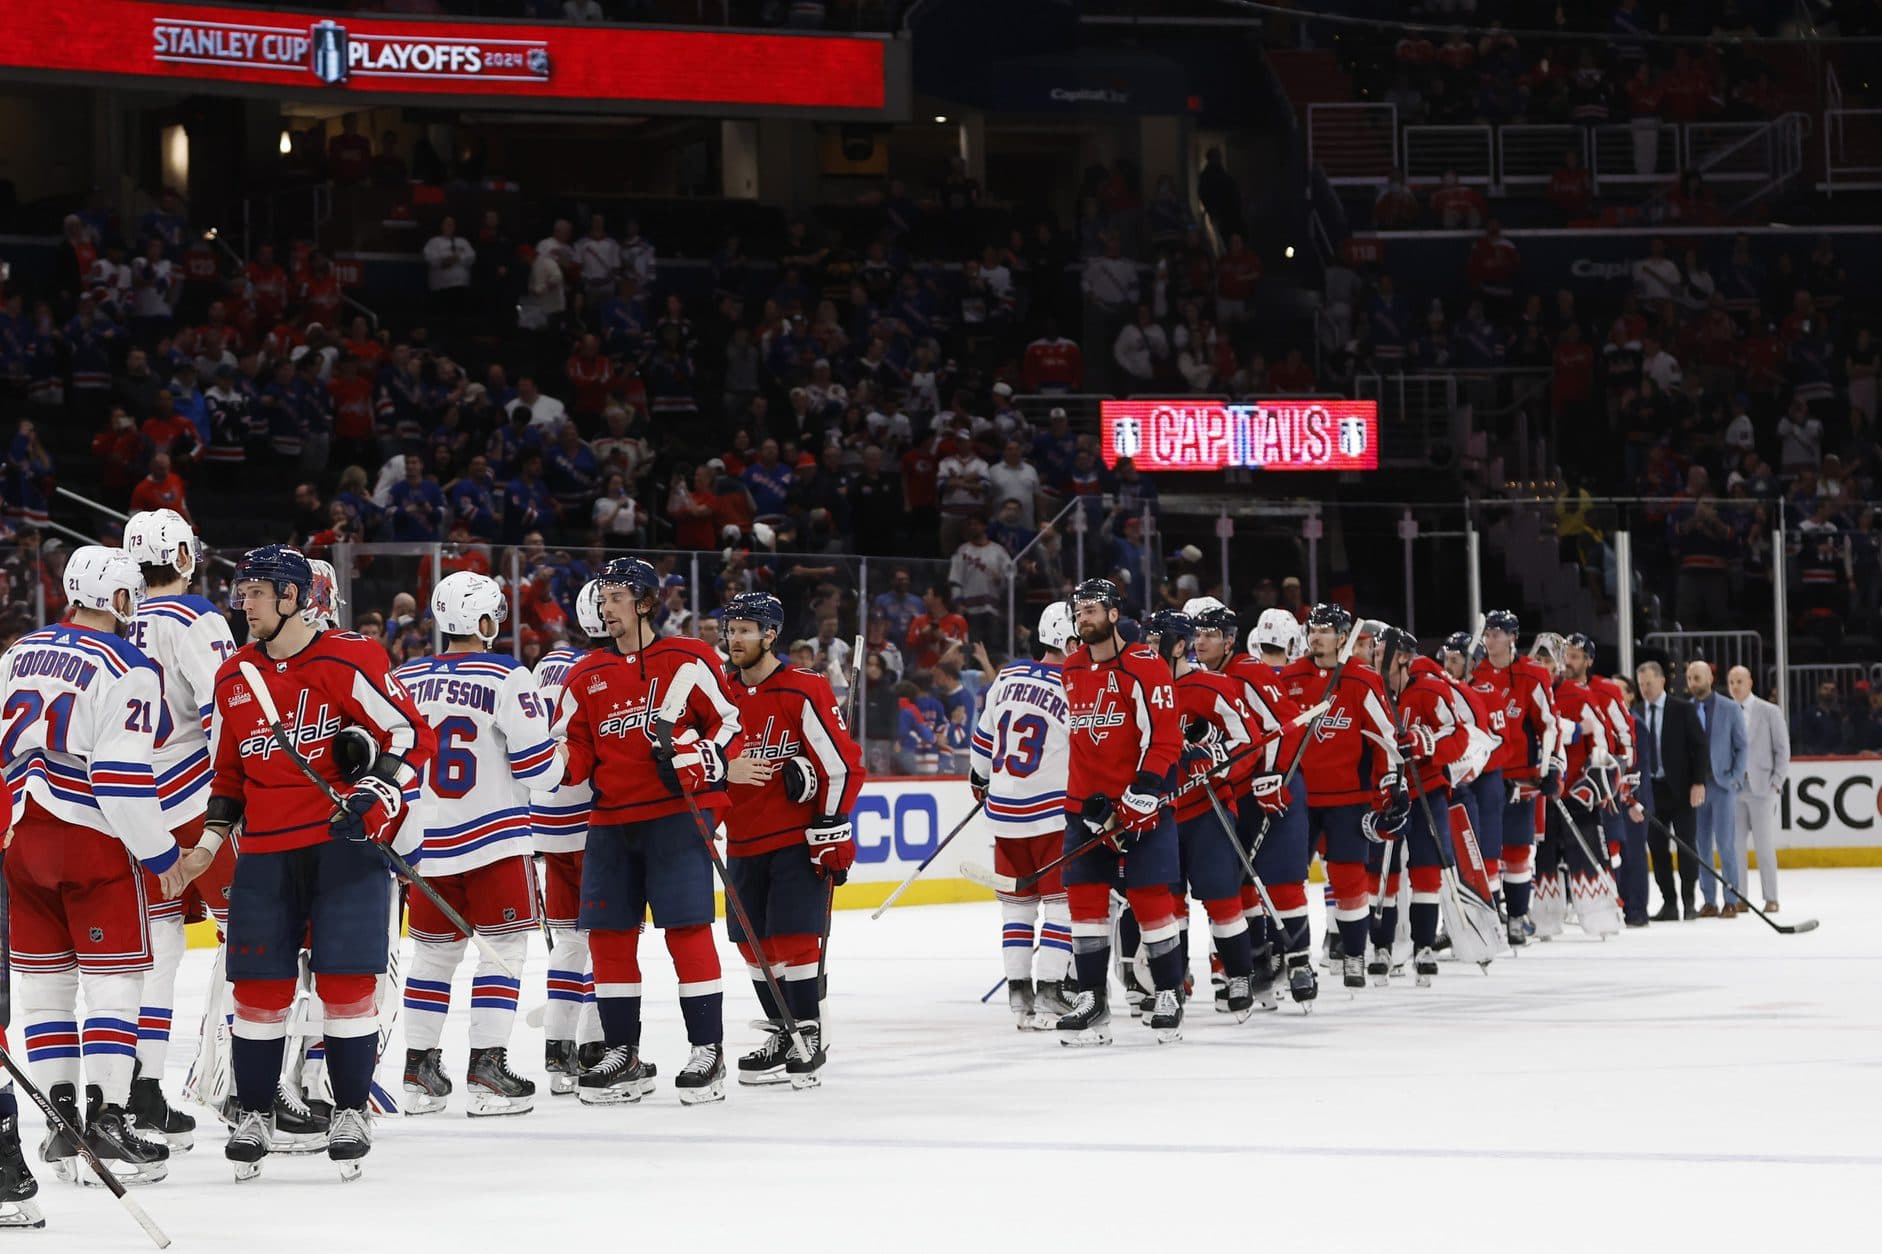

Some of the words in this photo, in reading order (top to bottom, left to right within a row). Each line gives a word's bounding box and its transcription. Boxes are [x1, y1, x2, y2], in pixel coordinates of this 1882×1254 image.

[153, 26, 257, 58] STANLEY
[262, 34, 308, 62] CUP
[348, 42, 482, 72] PLAYOFFS
[484, 51, 524, 67] 2024
[1570, 257, 1632, 280] Capi
[1150, 405, 1332, 465] CAPITALS
[130, 534, 143, 546] 73
[69, 578, 80, 591] 21
[436, 600, 447, 613] 56
[9, 649, 98, 692] GOODROW
[1107, 671, 1119, 693] A
[1151, 685, 1174, 710] 43
[125, 698, 153, 733] 21
[1488, 709, 1506, 731] 29
[0, 689, 77, 769] 21
[992, 710, 1049, 778] 13
[1780, 775, 1882, 831] ISC
[814, 828, 851, 842] CCM
